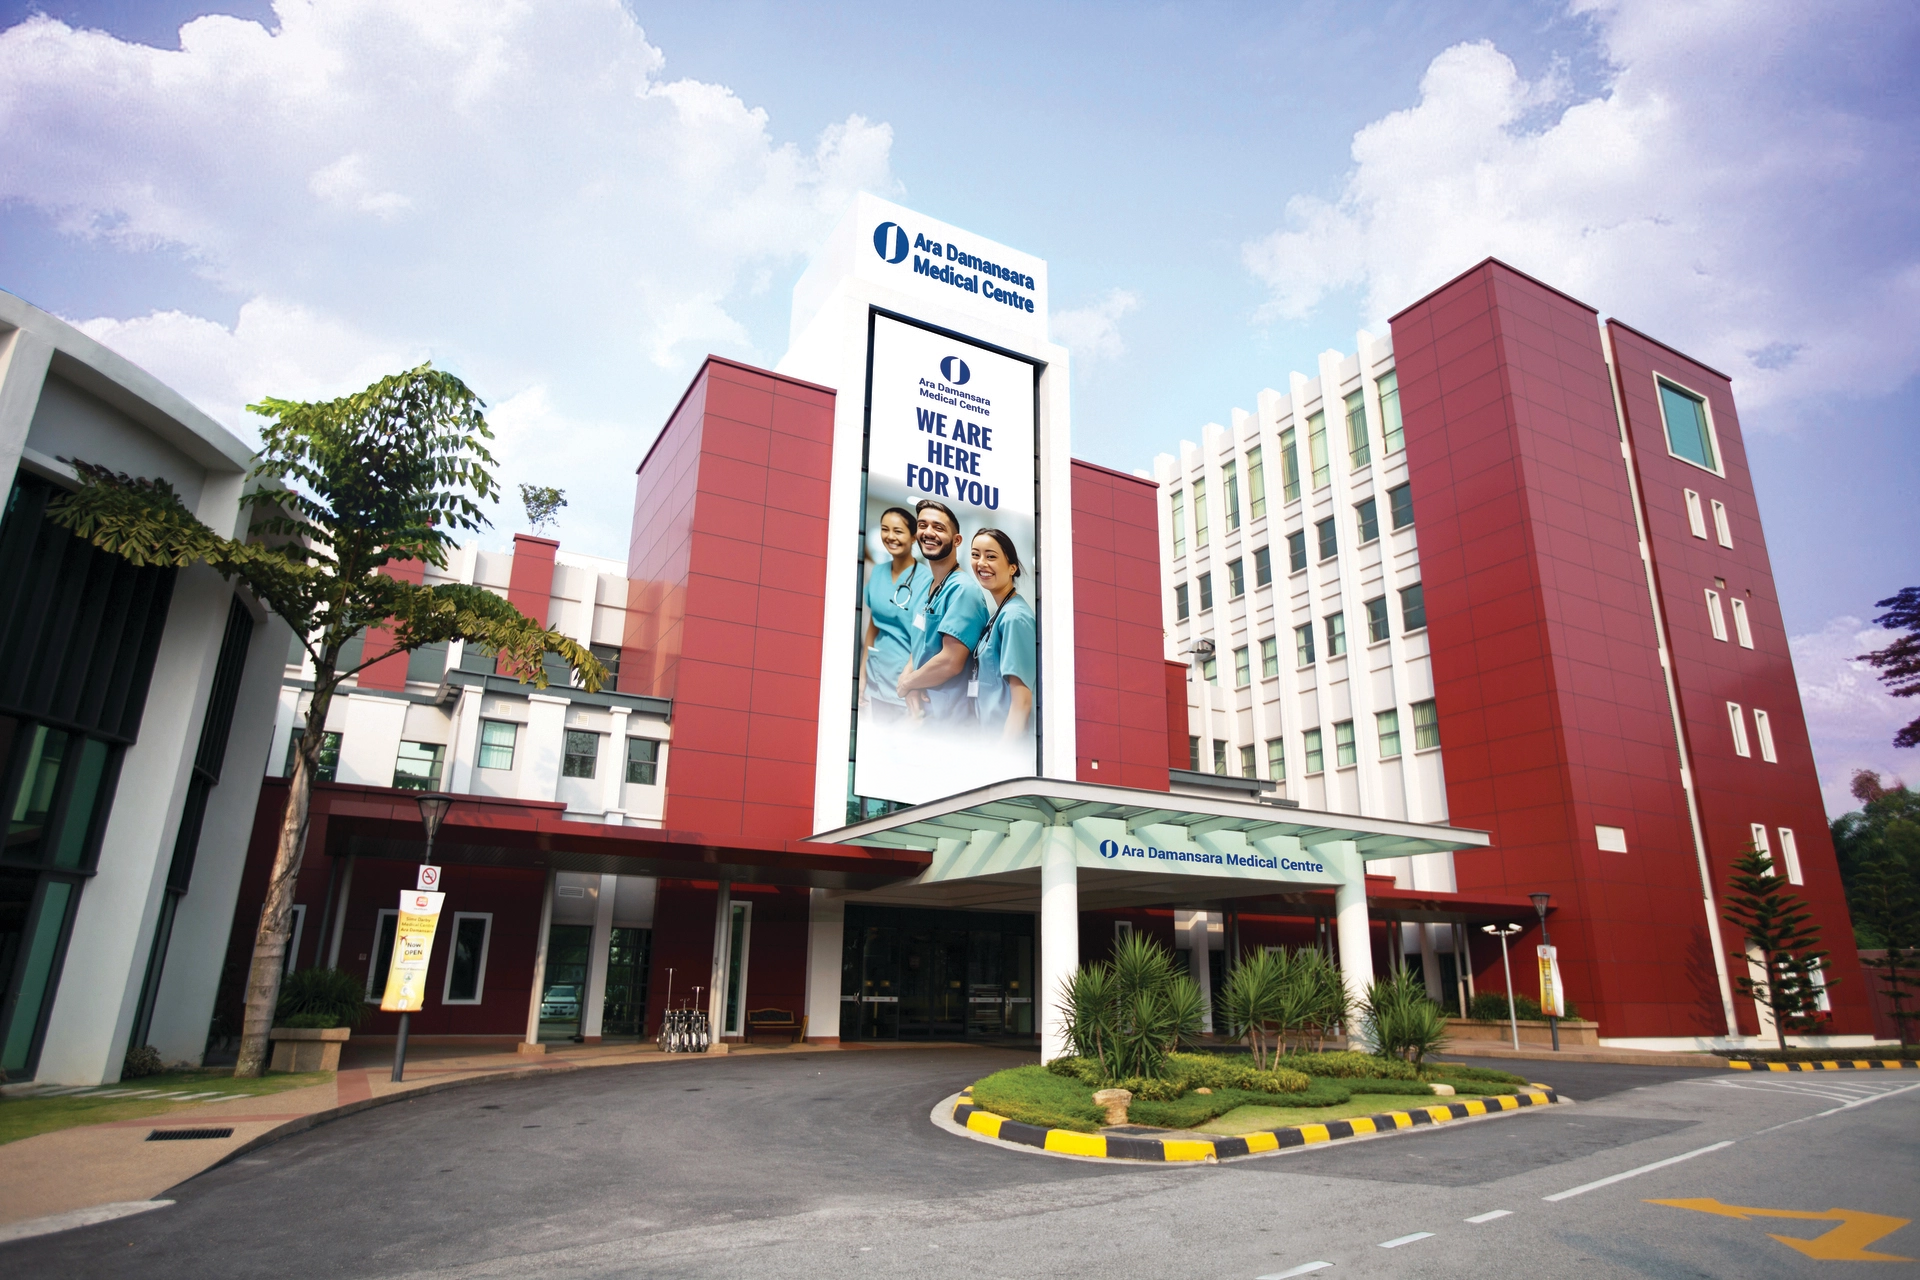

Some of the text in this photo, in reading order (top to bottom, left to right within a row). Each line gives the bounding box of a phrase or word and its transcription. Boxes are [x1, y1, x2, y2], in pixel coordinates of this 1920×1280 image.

[914, 233, 1035, 290] Ara Damansara
[914, 255, 1034, 313] Medical Centre
[918, 377, 991, 406] Ara Damansara
[919, 388, 990, 416] Medical Centre
[916, 407, 993, 451] WE ARE
[928, 439, 981, 477] HERE
[907, 463, 999, 510] FOR YOU
[1121, 844, 1324, 873] Ara Damansara Medical Centre
